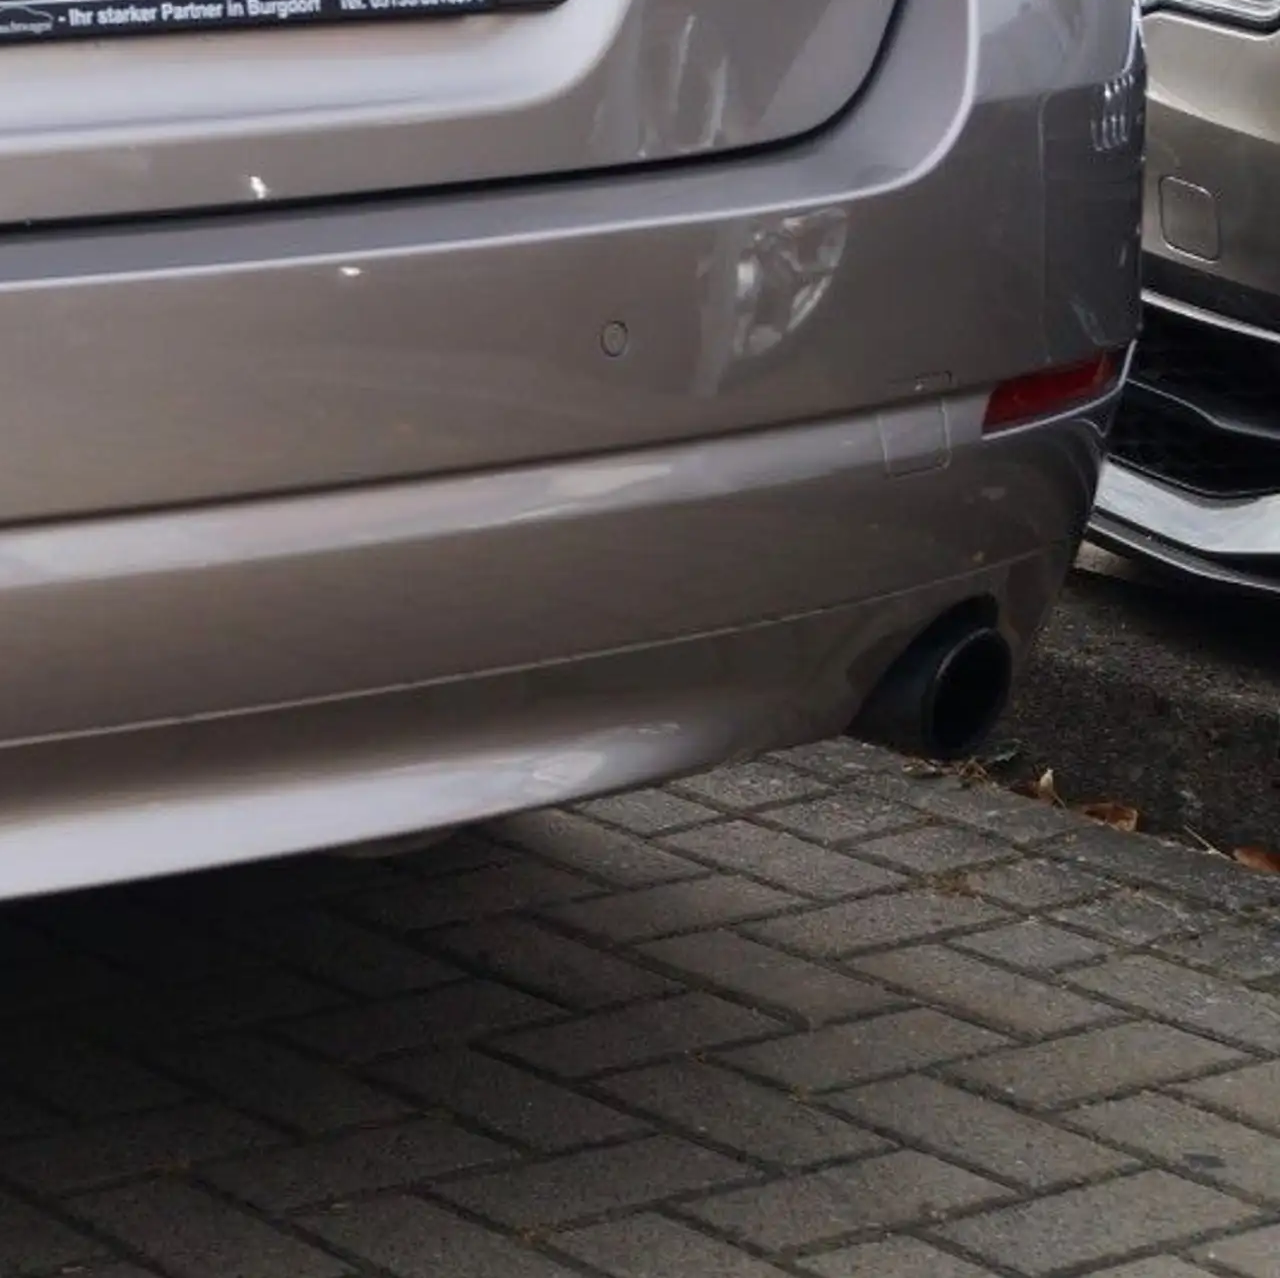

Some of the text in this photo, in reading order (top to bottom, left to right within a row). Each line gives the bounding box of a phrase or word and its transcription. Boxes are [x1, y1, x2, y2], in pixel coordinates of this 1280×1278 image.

[68, 8, 92, 27] Ihr
[96, 5, 158, 25] starker
[160, 1, 224, 21] Partner
